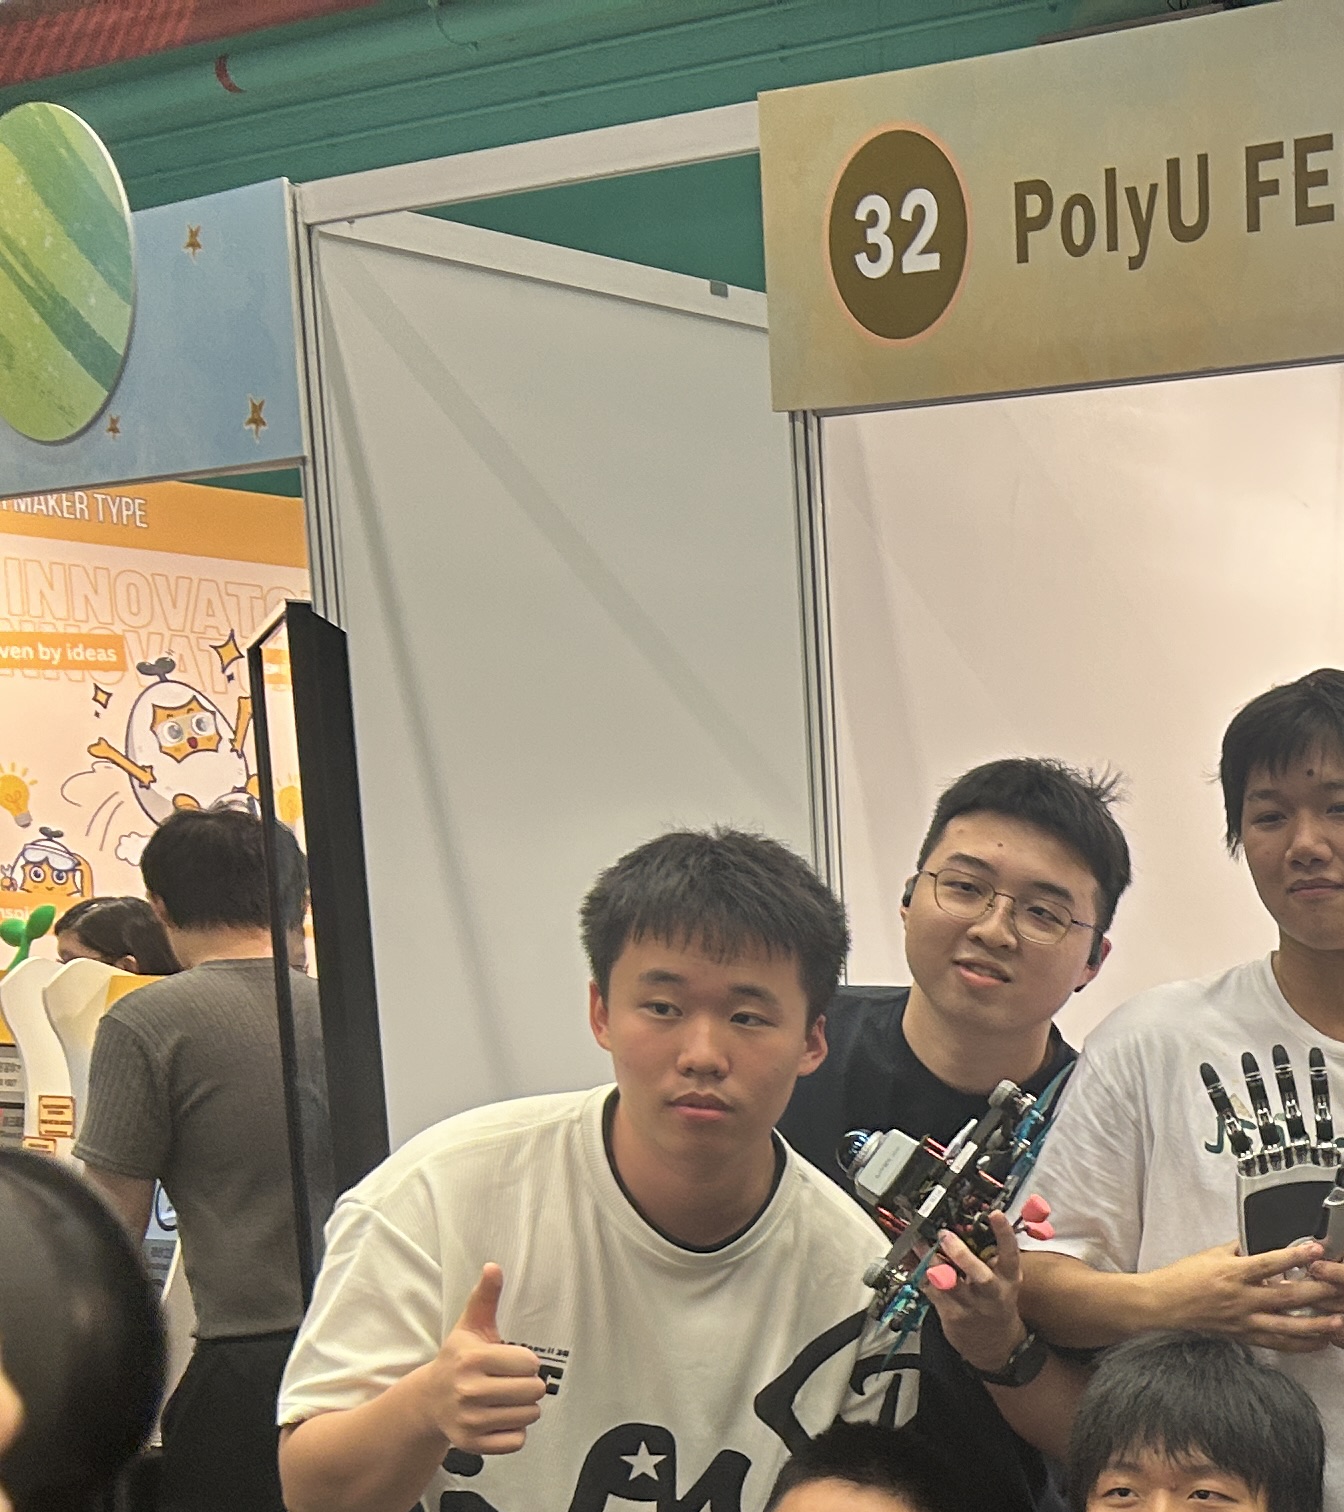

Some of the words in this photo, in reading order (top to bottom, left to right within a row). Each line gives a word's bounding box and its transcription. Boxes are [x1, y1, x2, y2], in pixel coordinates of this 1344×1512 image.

[854, 187, 941, 280] 32
[1013, 154, 1211, 271] PolyU
[93, 493, 149, 528] TYPE
[37, 642, 62, 664] by
[66, 643, 118, 662] ideas
